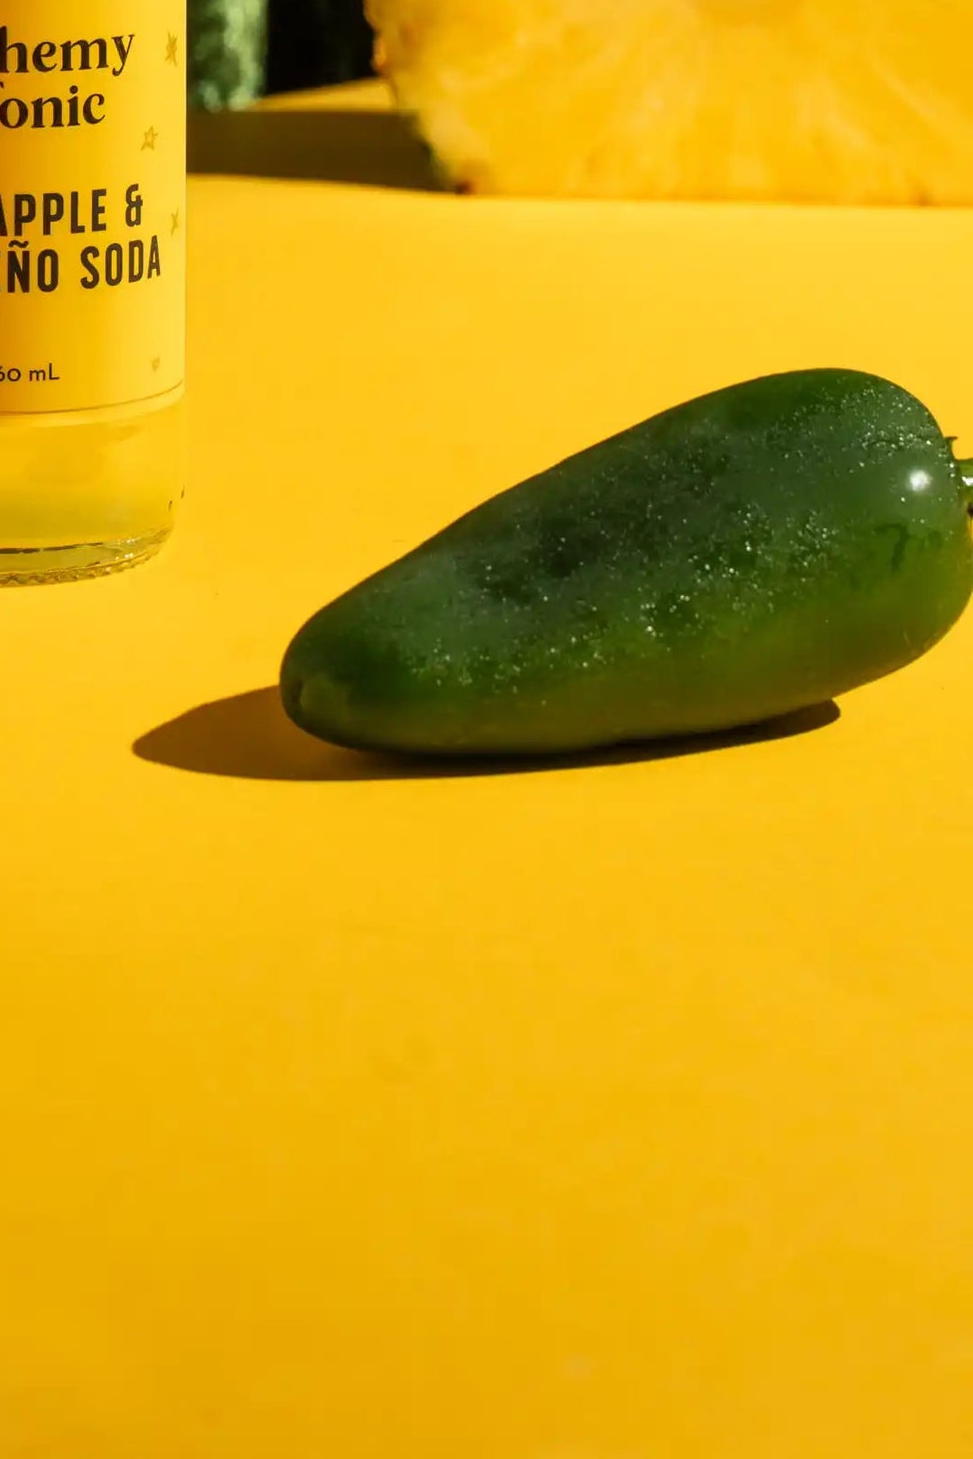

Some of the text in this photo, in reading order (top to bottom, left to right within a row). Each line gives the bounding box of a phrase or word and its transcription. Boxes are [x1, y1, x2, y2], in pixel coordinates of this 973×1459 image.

[124, 182, 144, 228] &
[79, 234, 162, 291] SODA
[28, 362, 61, 382] mL
